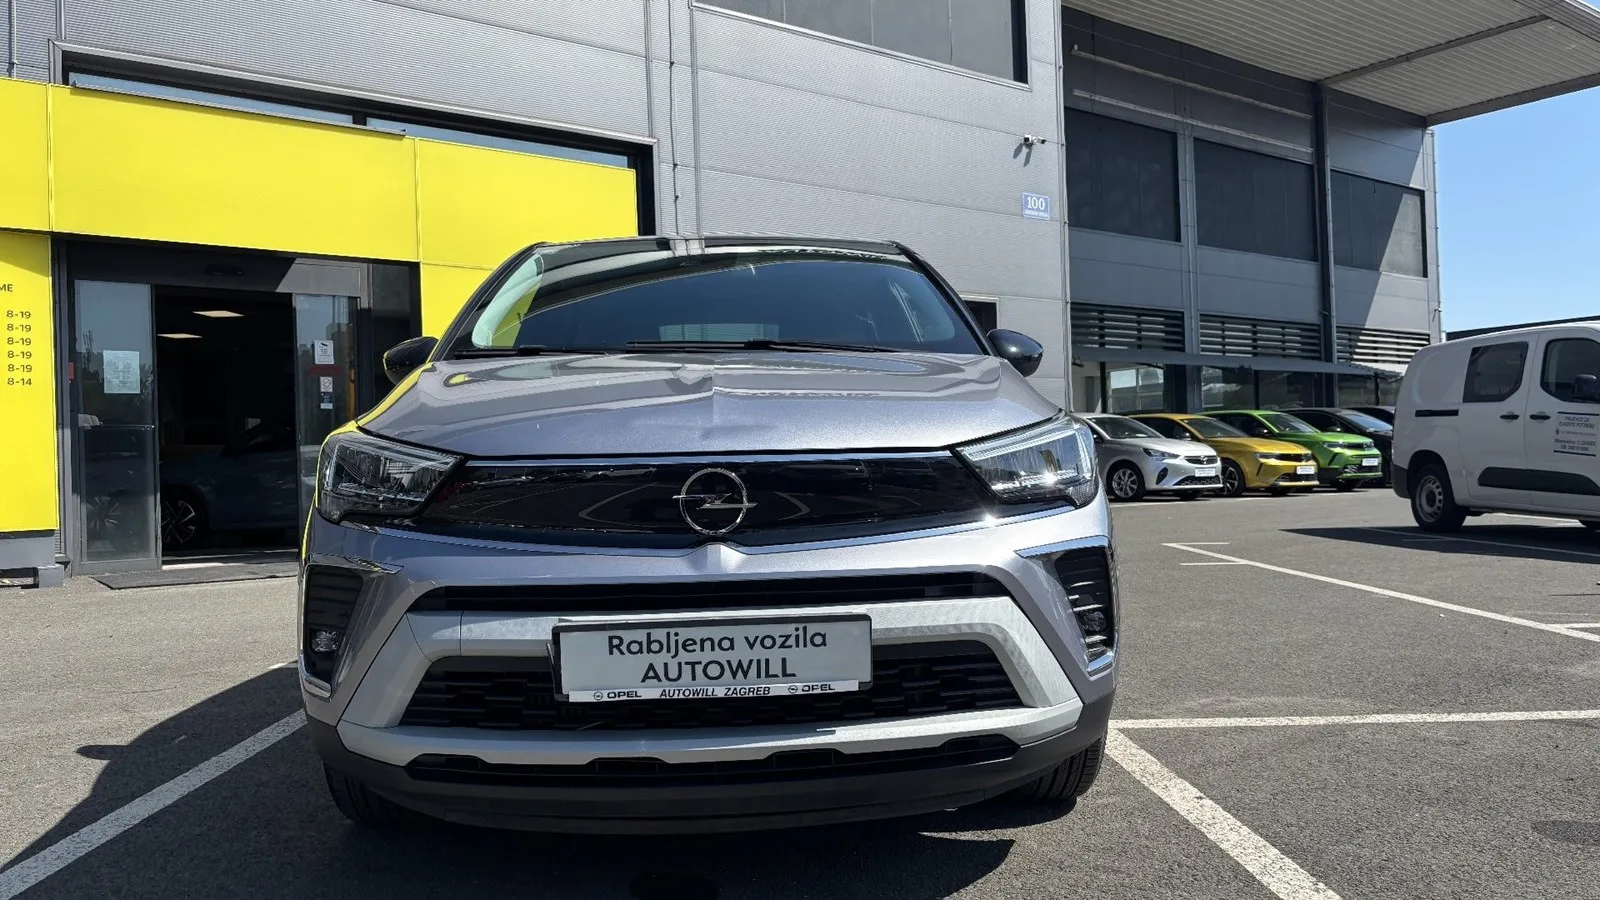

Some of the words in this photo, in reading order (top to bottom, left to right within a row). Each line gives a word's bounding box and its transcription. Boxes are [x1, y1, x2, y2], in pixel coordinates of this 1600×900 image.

[1027, 196, 1045, 210] 100
[608, 631, 735, 659] Rabljena
[744, 625, 827, 650] vozila
[640, 657, 797, 683] AUTOWILL
[606, 690, 642, 699] OPEL
[659, 687, 718, 699] AUTOWILL
[723, 686, 771, 697] ZAGREB
